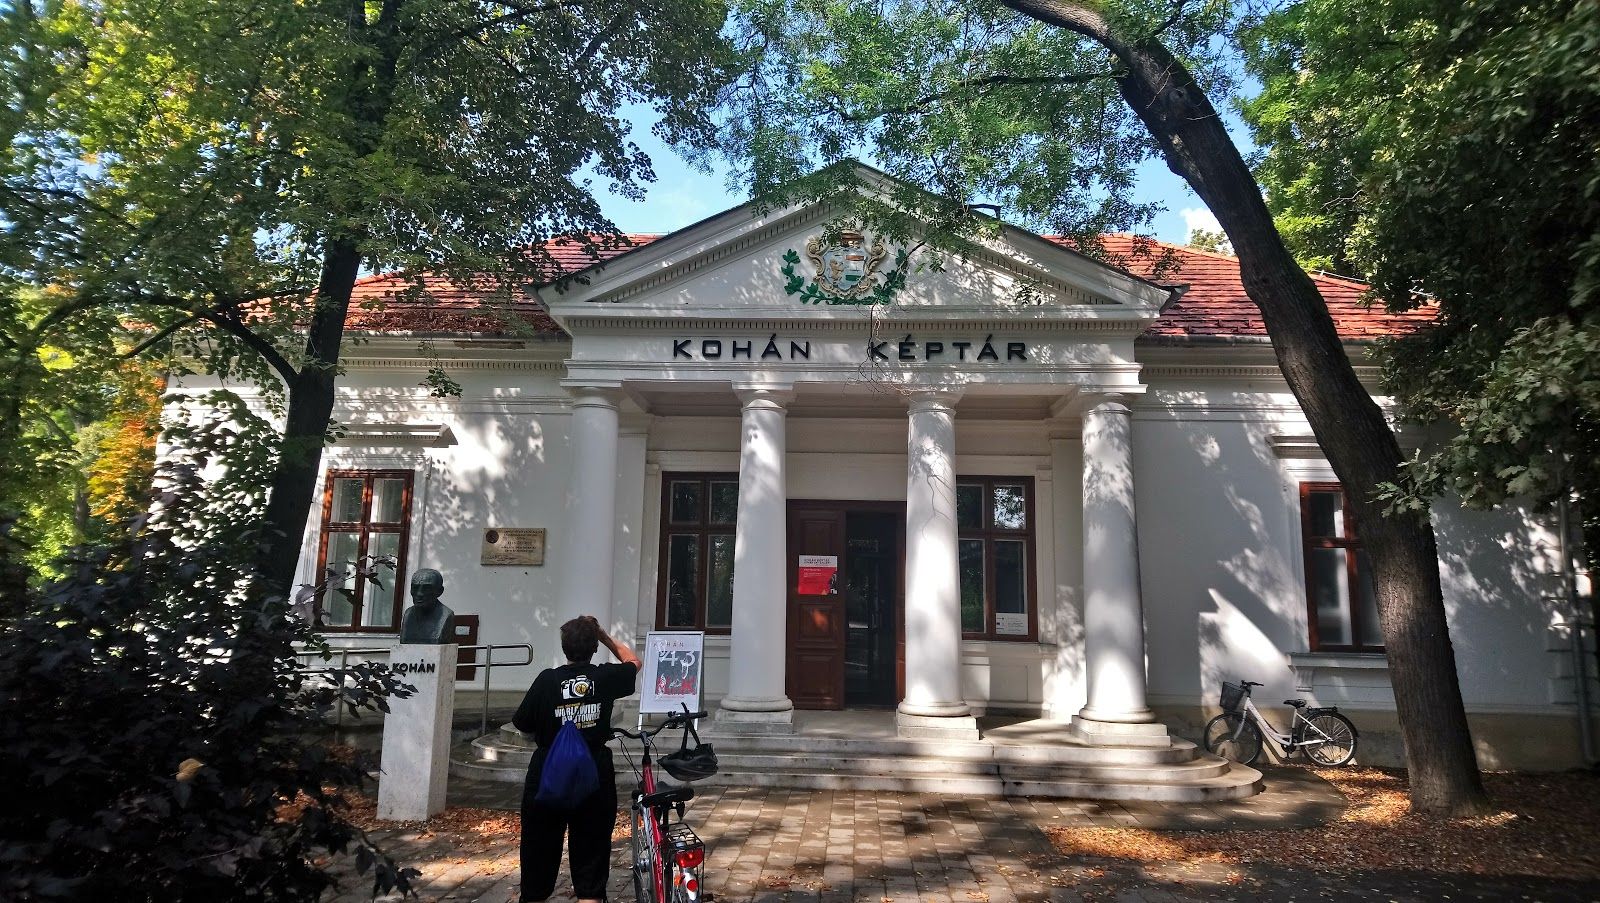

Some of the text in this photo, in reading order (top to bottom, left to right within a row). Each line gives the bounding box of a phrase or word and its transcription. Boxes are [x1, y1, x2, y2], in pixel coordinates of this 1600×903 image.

[673, 333, 1028, 361] KOHÁN KÉPTÁR
[392, 658, 436, 673] KOHÁN
